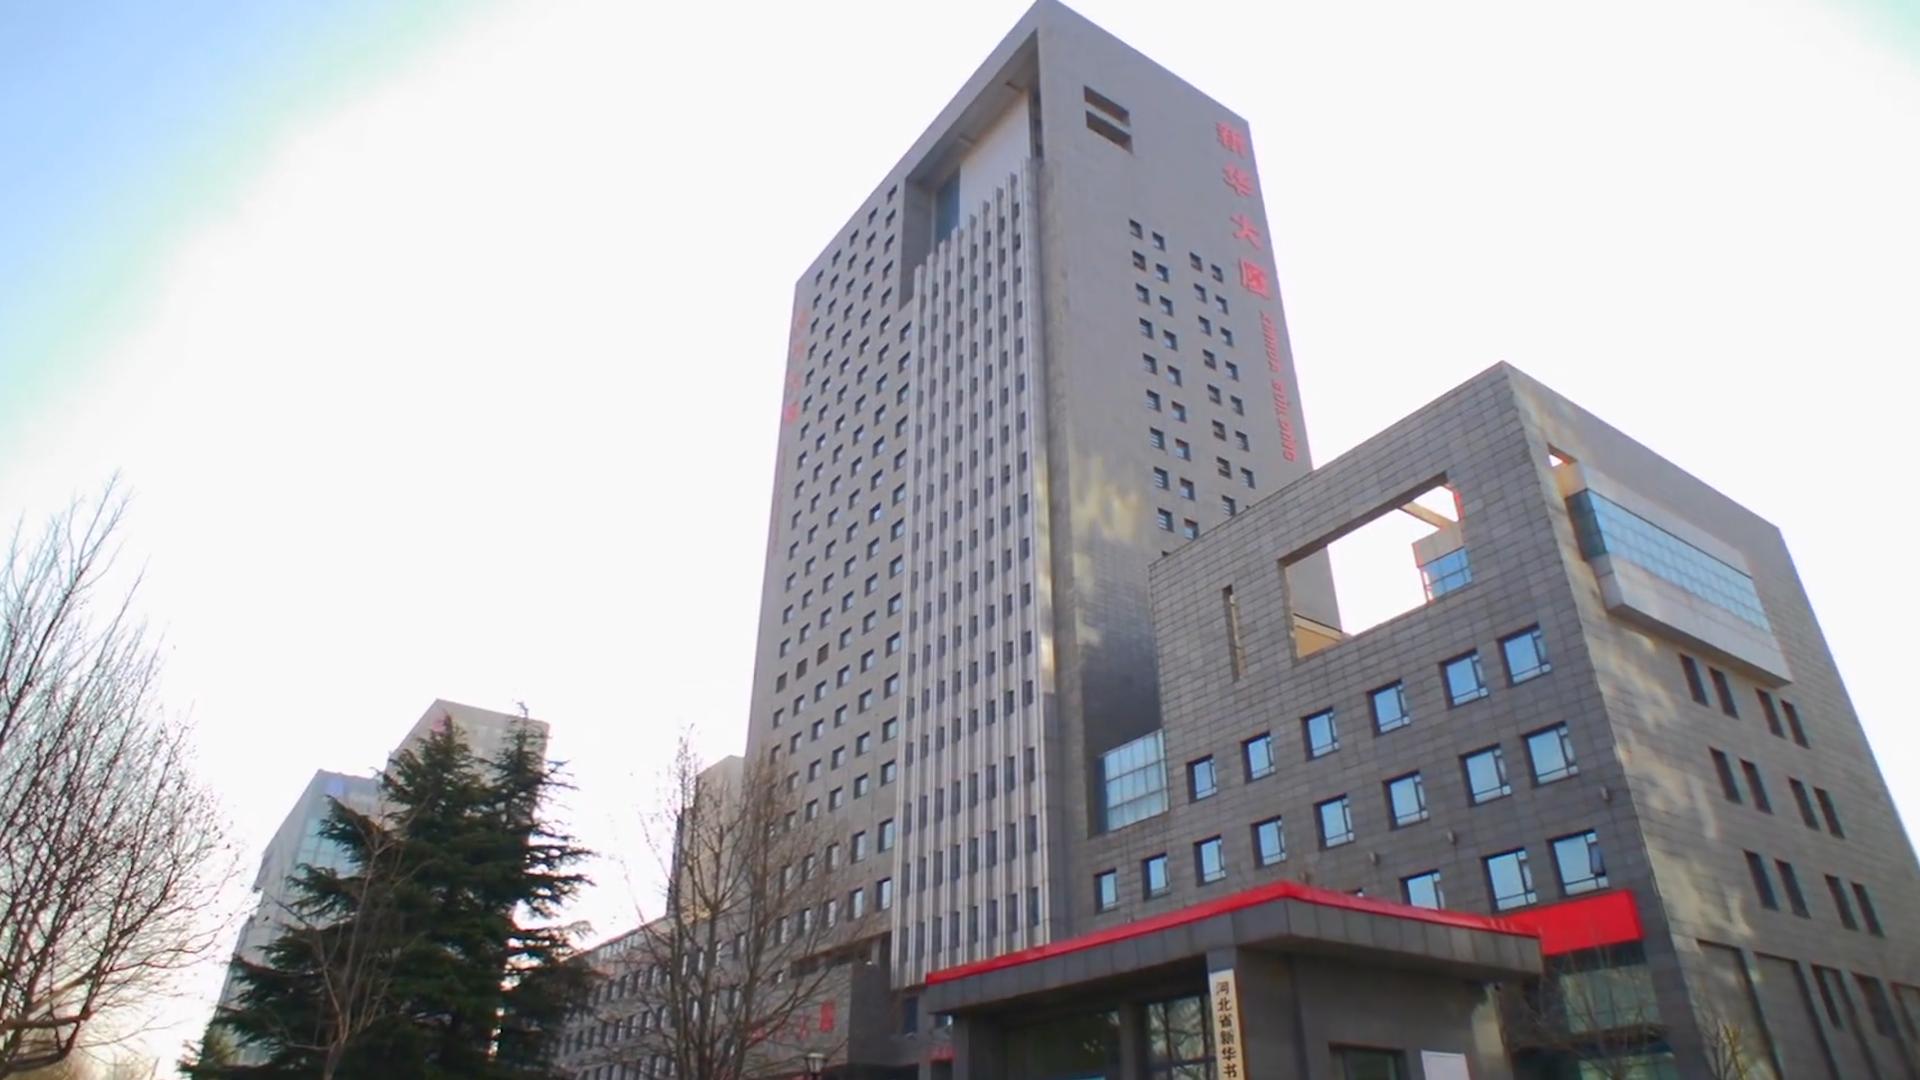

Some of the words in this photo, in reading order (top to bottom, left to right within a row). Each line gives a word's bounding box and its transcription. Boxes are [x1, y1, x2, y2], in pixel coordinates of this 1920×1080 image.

[1216, 981, 1238, 1078] 河北省新华书
